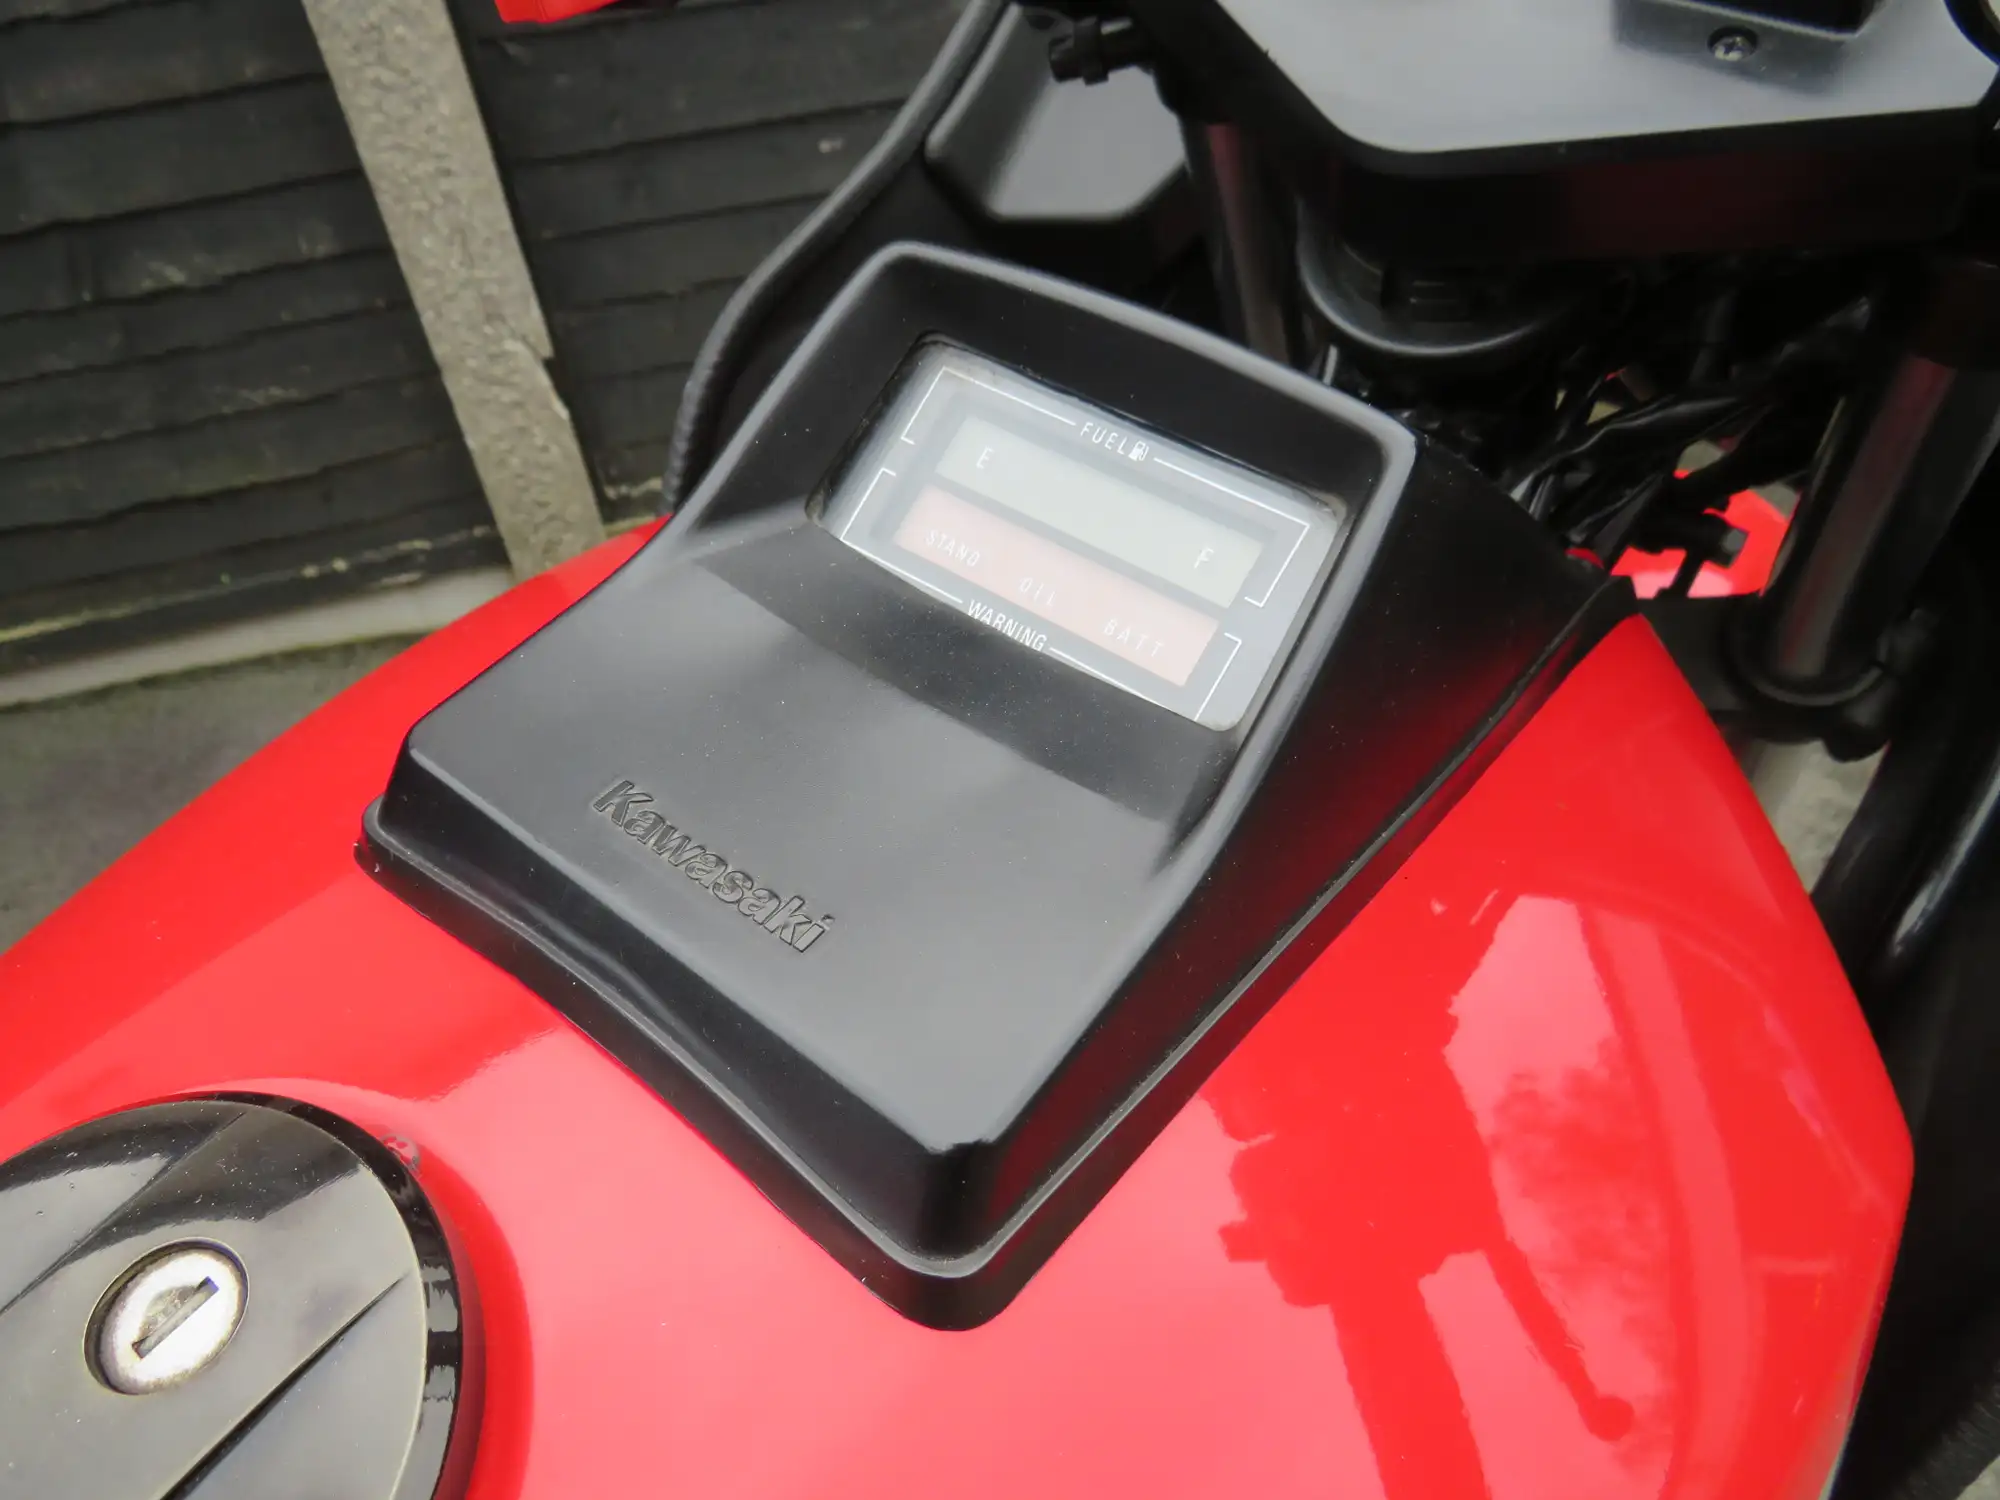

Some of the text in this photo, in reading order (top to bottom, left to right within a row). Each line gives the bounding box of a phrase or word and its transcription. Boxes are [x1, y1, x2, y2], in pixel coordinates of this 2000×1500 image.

[1080, 423, 1127, 455] FUEL
[976, 446, 992, 469] E
[925, 531, 980, 566] STAND
[1194, 548, 1215, 569] F
[1019, 577, 1056, 607] OIL
[967, 599, 1047, 651] WARNING
[1104, 620, 1164, 657] BATT
[593, 780, 835, 953] Kawasaki
